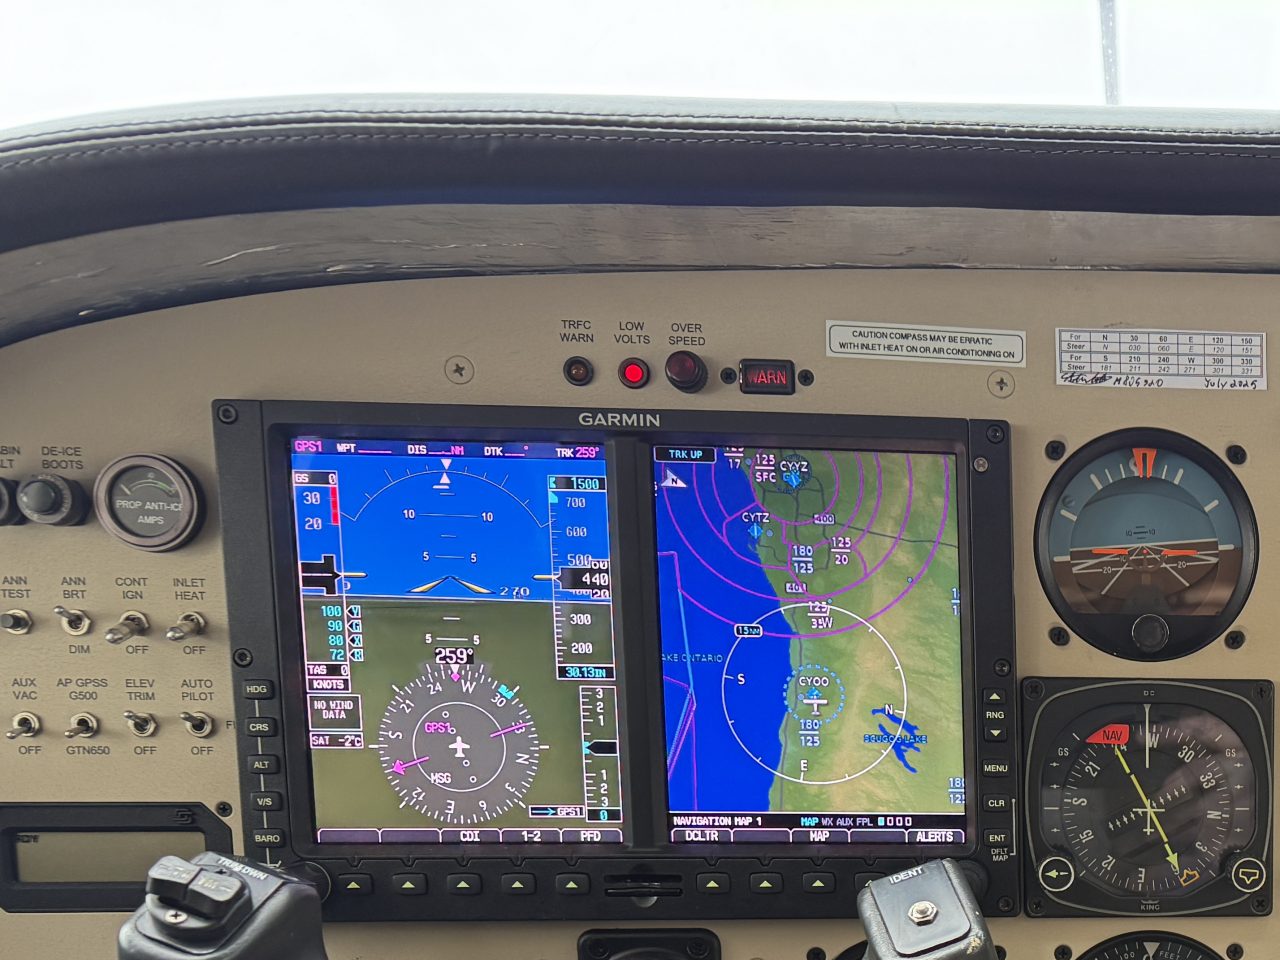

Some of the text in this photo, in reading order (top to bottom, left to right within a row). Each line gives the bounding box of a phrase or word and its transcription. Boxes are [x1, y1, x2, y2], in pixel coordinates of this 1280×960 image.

[561, 320, 592, 330] TRFC
[619, 321, 645, 331] LOW
[671, 323, 703, 333] OVER
[560, 333, 594, 343] WARN
[614, 334, 650, 345] VOLTS
[668, 336, 706, 346] SPEED
[852, 330, 888, 339] CAUTION
[889, 332, 928, 341] COMPASS
[930, 334, 946, 342] MAY
[960, 337, 992, 345] ERRATIC
[839, 342, 859, 350] WITH
[861, 343, 882, 351] INLET
[883, 344, 904, 352] HEAT
[947, 348, 1000, 358] CONDITIONING
[747, 367, 789, 385] WARN
[578, 412, 661, 428] GARMIN
[41, 447, 81, 456] DE-ICE
[556, 447, 600, 458] TRK 259°
[42, 460, 83, 469] BOOTS
[780, 461, 809, 471] CYYZ
[116, 500, 142, 509] PROP
[742, 512, 770, 522] CYTZ
[2, 576, 28, 585] ANN
[61, 576, 86, 586] ANN
[115, 577, 148, 587] CONT
[173, 578, 206, 588] INLET
[1, 589, 31, 598] TEST
[64, 590, 86, 599] BRT
[122, 590, 143, 600] IGN
[174, 590, 206, 600] HEAT
[68, 644, 90, 654] DIM
[126, 645, 149, 654] OFF
[183, 645, 206, 654] OFF
[12, 678, 38, 688] AUX
[56, 678, 108, 688] AP GPSS
[126, 678, 154, 688] ELEV
[181, 679, 212, 689] AUTO
[313, 679, 344, 690] KNOTS
[799, 677, 829, 686] CYOO
[246, 684, 267, 694] HDG
[13, 691, 38, 700] VAC
[69, 691, 98, 701] G500
[127, 692, 155, 701] TRIM
[182, 692, 214, 702] PILOT
[986, 711, 1005, 719] RNG
[249, 722, 269, 732] CRS
[18, 746, 42, 755] OFF
[66, 746, 110, 756] GTN650
[134, 746, 156, 756] OFF
[191, 746, 214, 756] OFF
[254, 760, 270, 769] ALT
[984, 764, 1008, 772] MENU
[988, 799, 1005, 807] CLR
[254, 834, 280, 843] BARO
[460, 831, 481, 842] CDI
[581, 831, 601, 841] PFD
[685, 831, 719, 841] DCLTR
[916, 831, 954, 842] ALERTS
[989, 834, 1005, 842] ENT
